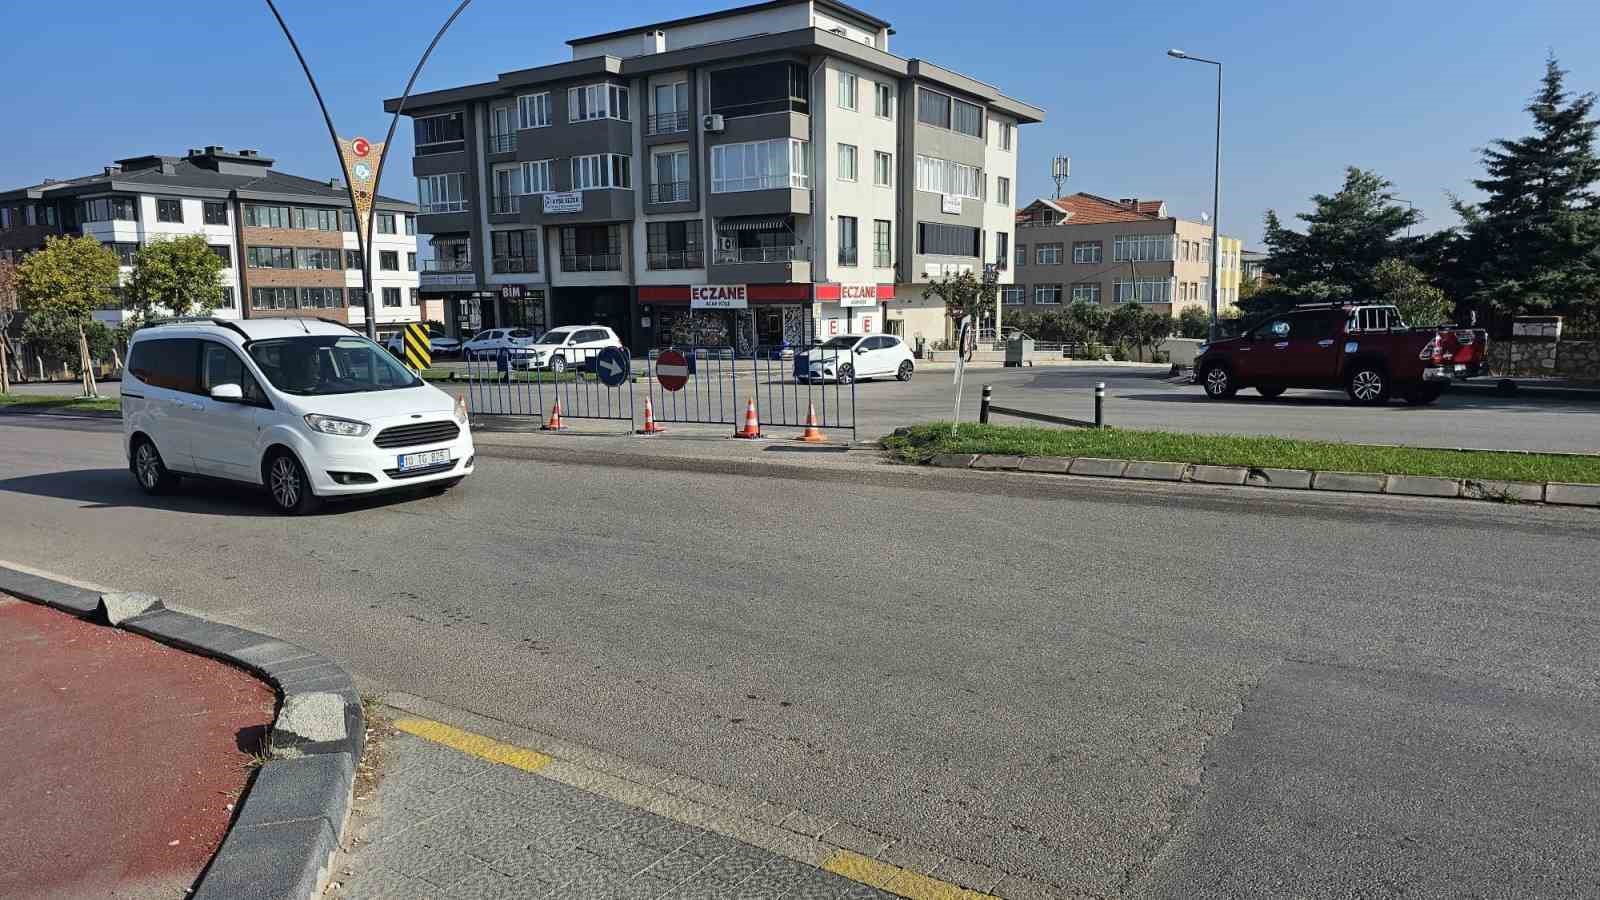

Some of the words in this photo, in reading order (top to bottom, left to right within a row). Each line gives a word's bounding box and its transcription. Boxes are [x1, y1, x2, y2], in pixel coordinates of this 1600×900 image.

[692, 287, 745, 300] ECZANE
[841, 286, 876, 298] ECZANE
[830, 320, 837, 335] E
[864, 319, 871, 333] E
